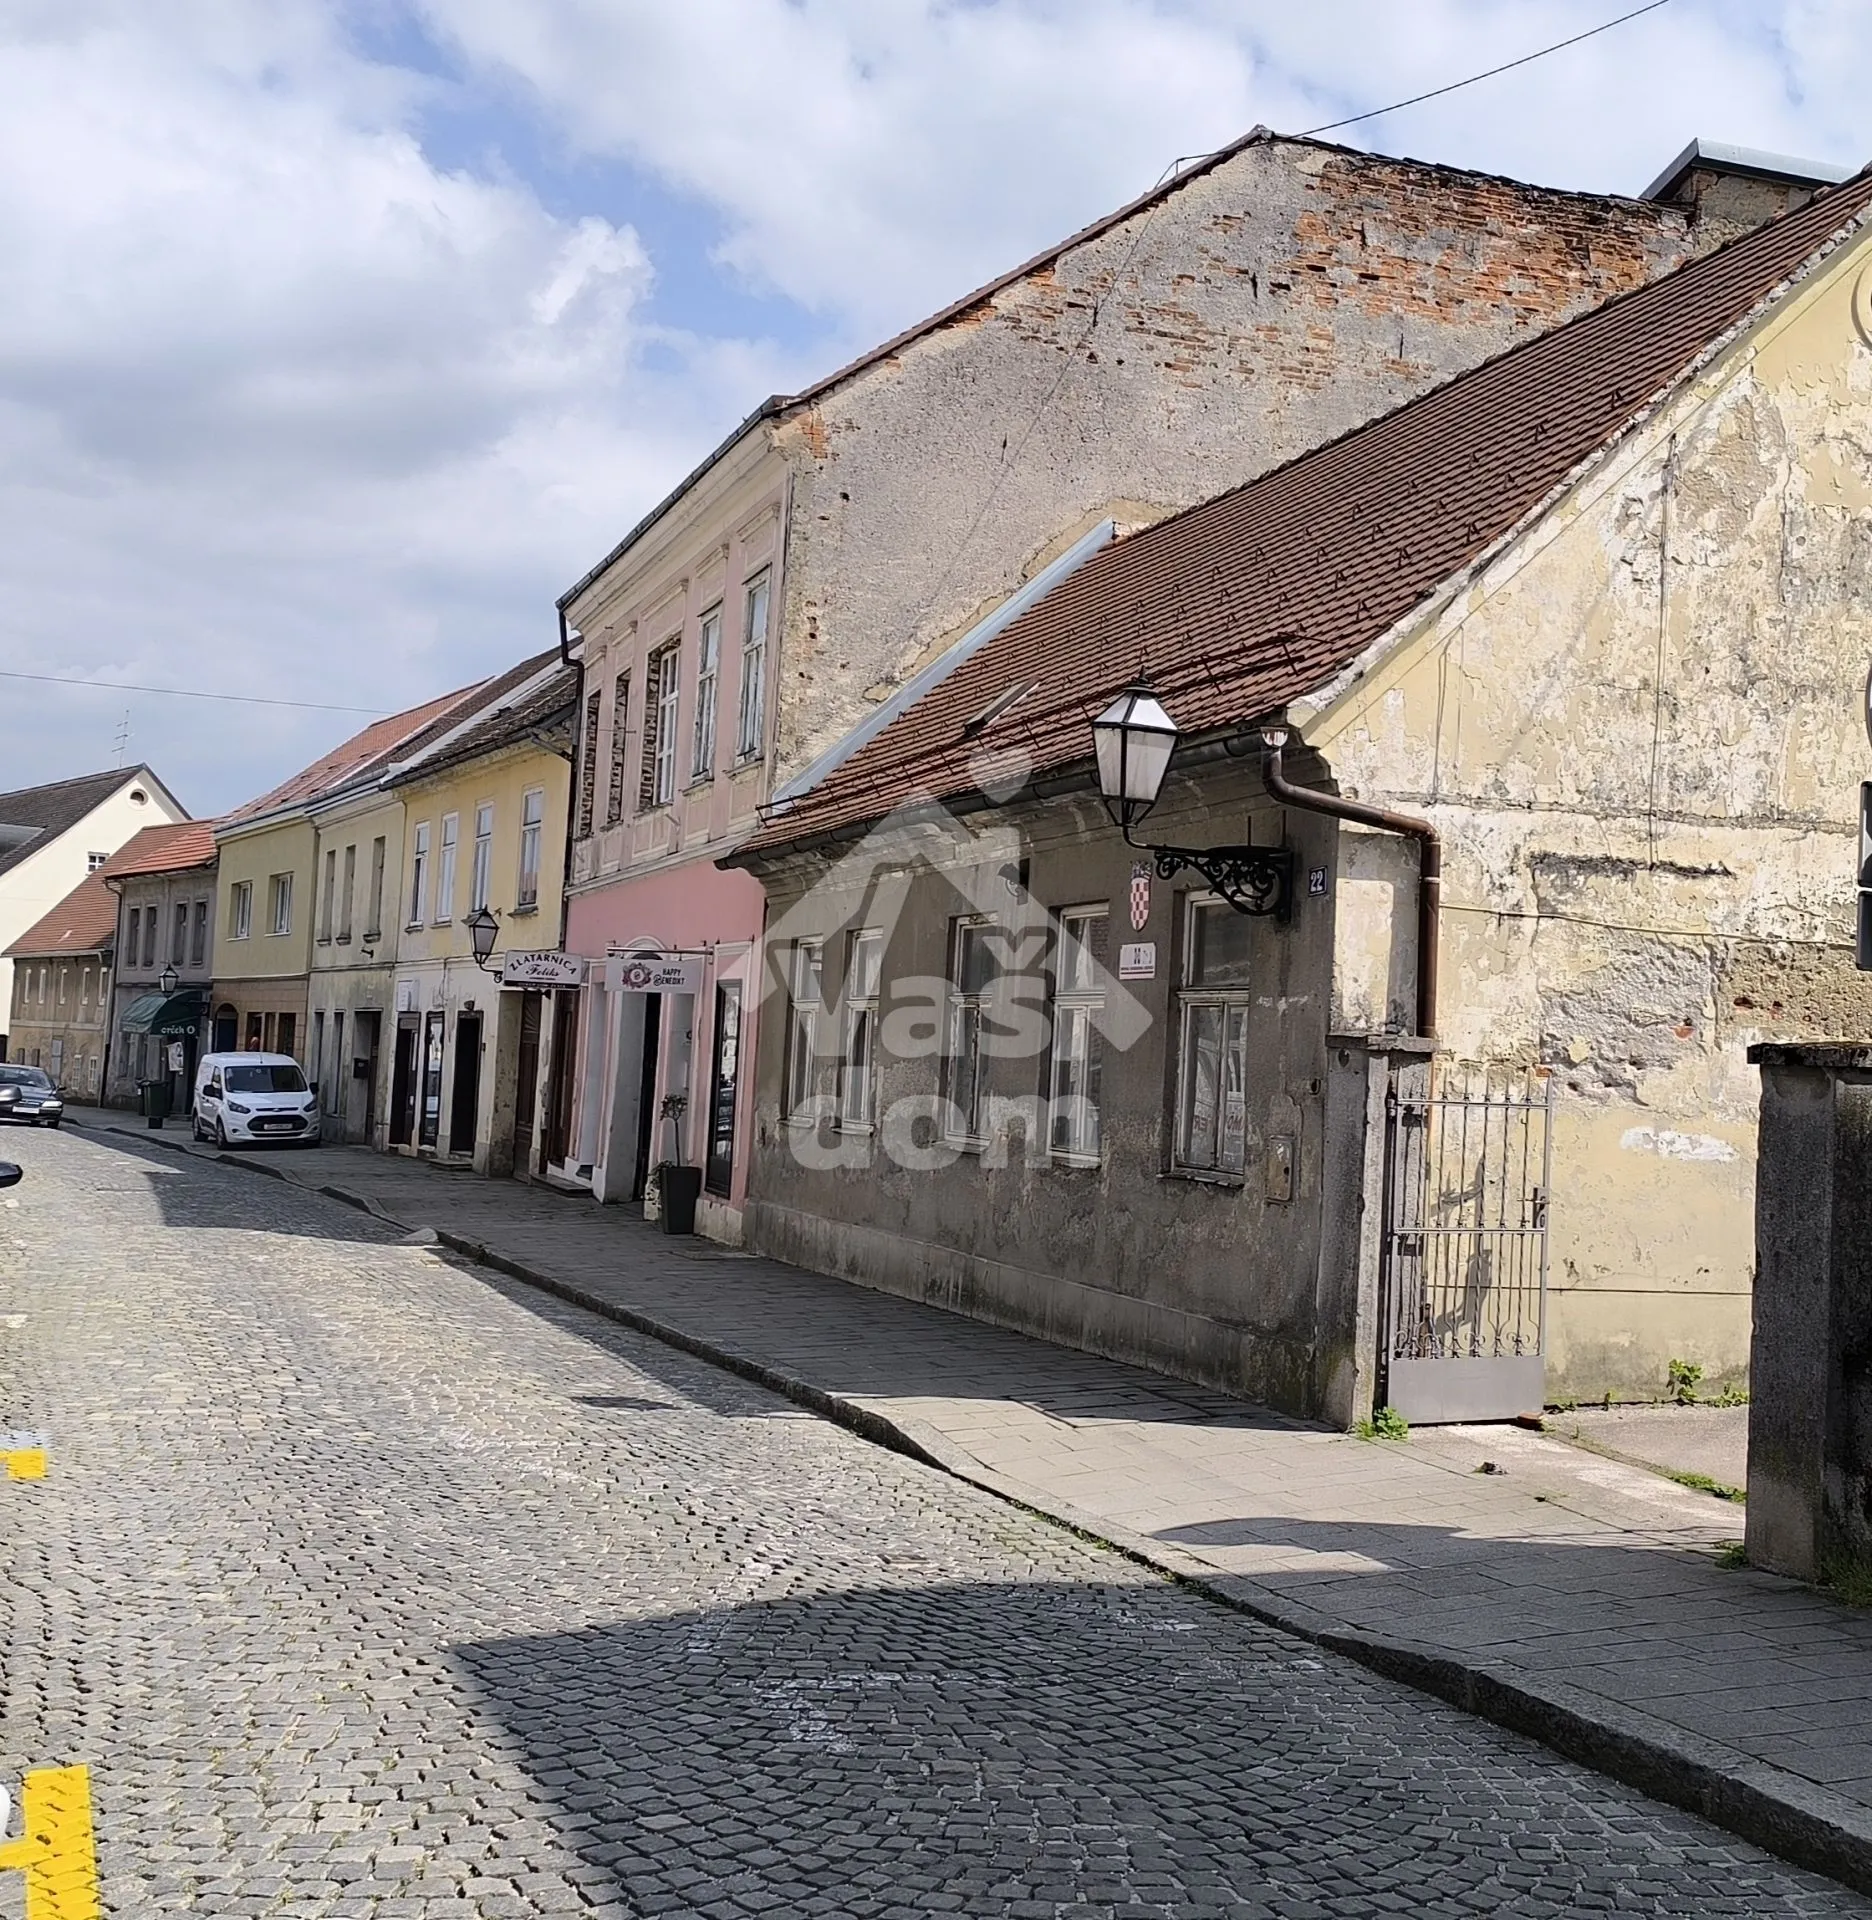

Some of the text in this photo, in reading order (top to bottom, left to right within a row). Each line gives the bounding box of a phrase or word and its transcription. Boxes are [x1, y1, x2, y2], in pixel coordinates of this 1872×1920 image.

[1310, 870, 1323, 892] 22
[509, 953, 577, 975] ZLATARNICA
[662, 968, 682, 976] HAPPY
